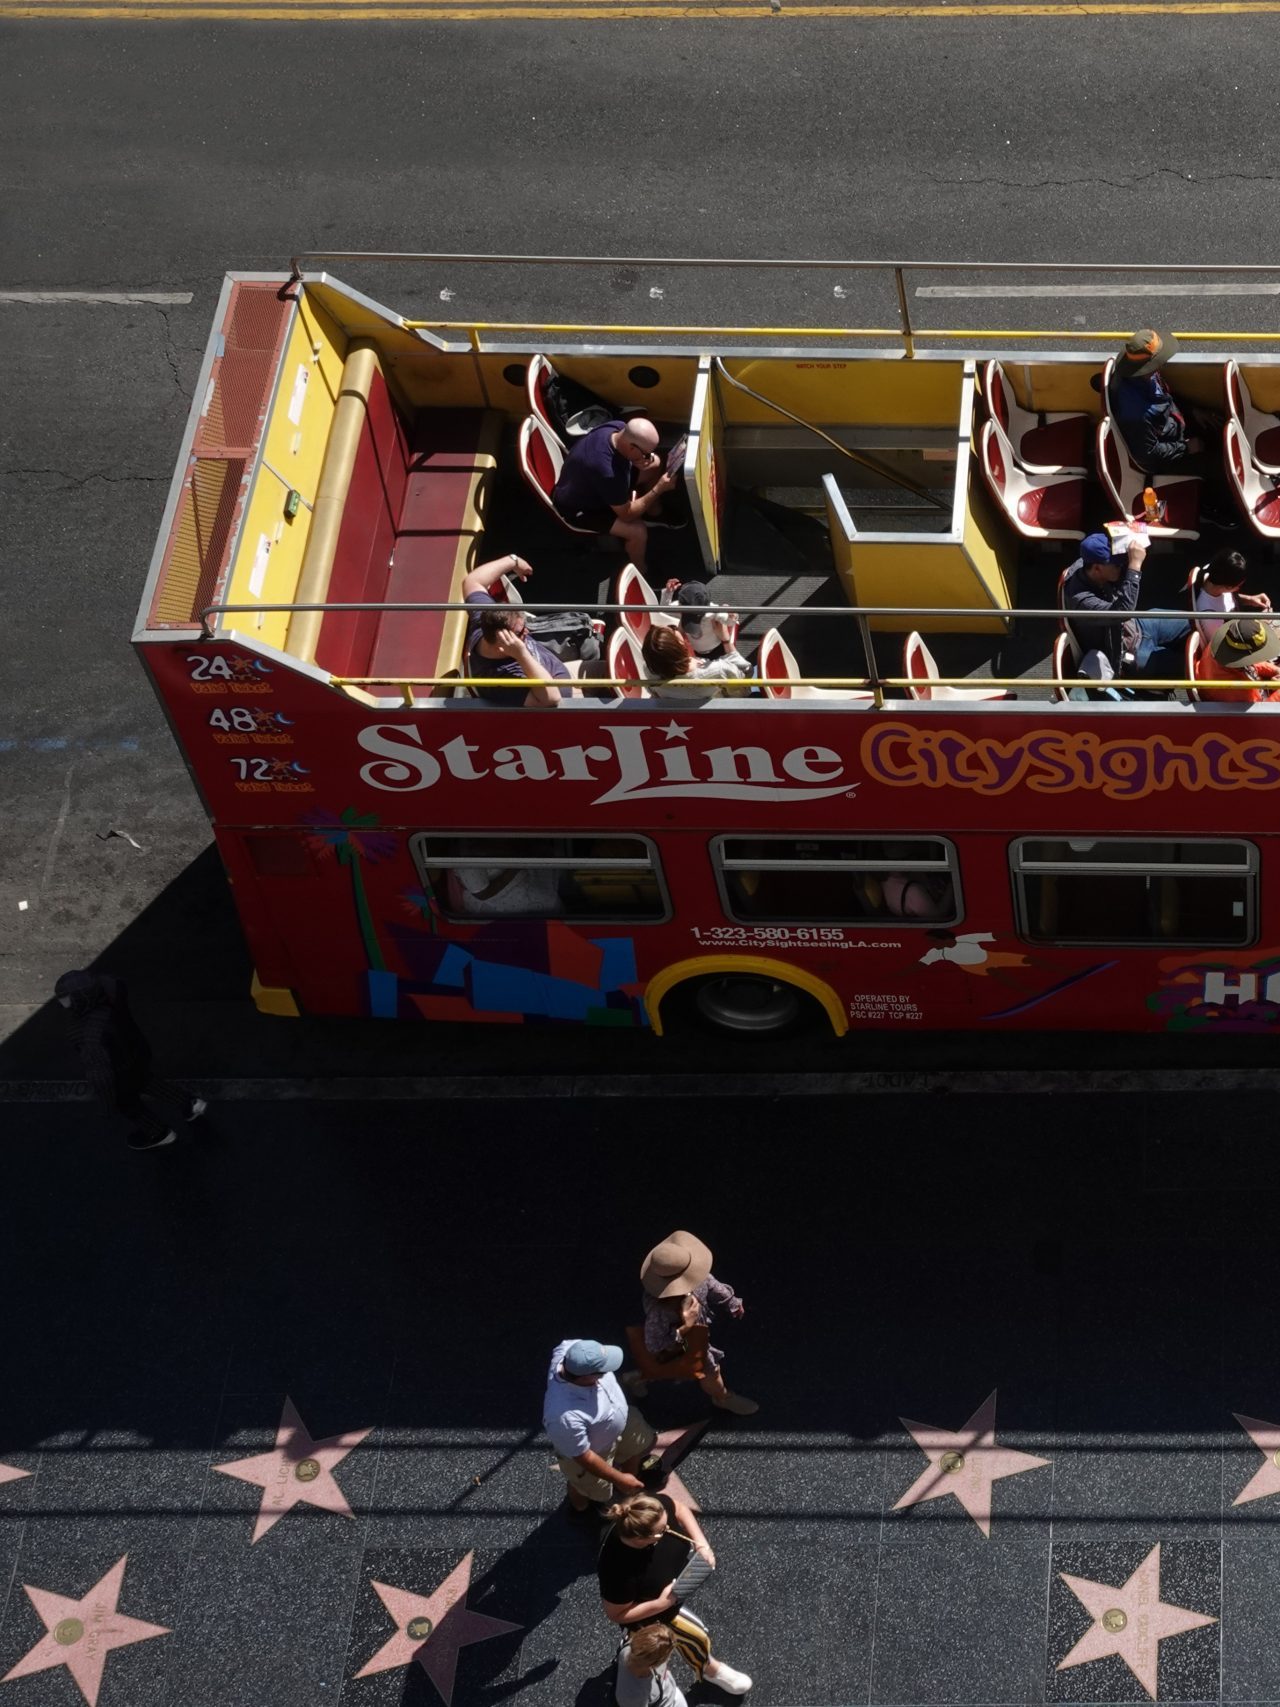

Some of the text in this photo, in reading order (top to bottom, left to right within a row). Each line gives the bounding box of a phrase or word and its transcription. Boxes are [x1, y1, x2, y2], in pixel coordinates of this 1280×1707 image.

[186, 655, 233, 681] 24
[209, 707, 257, 732] 48
[230, 757, 273, 781] 72
[357, 719, 862, 805] StarLine
[690, 926, 845, 940] 1-323-580-6155
[698, 939, 902, 949] www.CitySightseeingLA.com
[850, 1003, 918, 1012] STARLINE TOURS
[854, 994, 911, 1003] OPERATED BY
[850, 1011, 923, 1020] PSC #227 TCP #227
[85, 1602, 107, 1660] JIM GRAY
